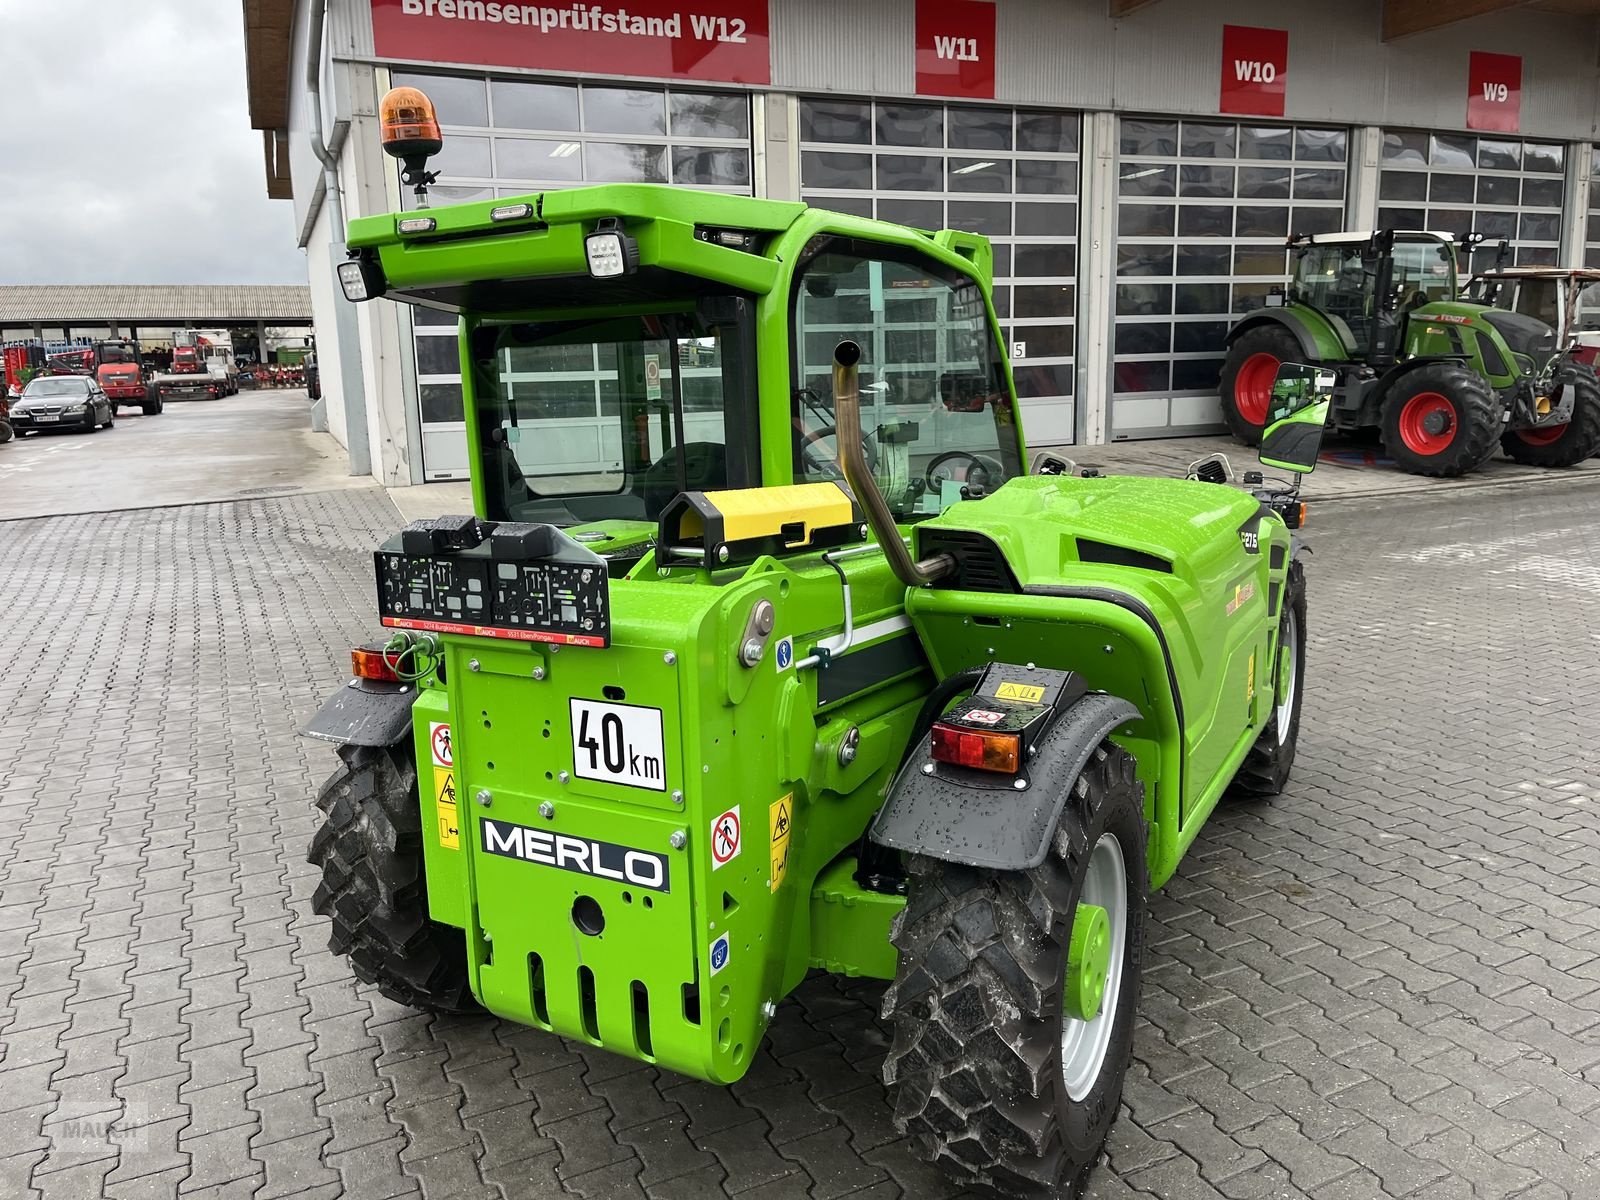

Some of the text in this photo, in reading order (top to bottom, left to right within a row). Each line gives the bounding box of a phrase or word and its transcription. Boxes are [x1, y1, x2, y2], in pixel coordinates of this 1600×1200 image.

[402, 0, 747, 43] Bremsenprüfstand W12
[934, 35, 979, 61] W11
[1235, 60, 1275, 83] W10
[1483, 82, 1508, 102] W9
[1093, 240, 1099, 249] 5
[1015, 343, 1023, 357] 5
[578, 710, 660, 780] 40 km
[484, 820, 664, 888] MERLO
